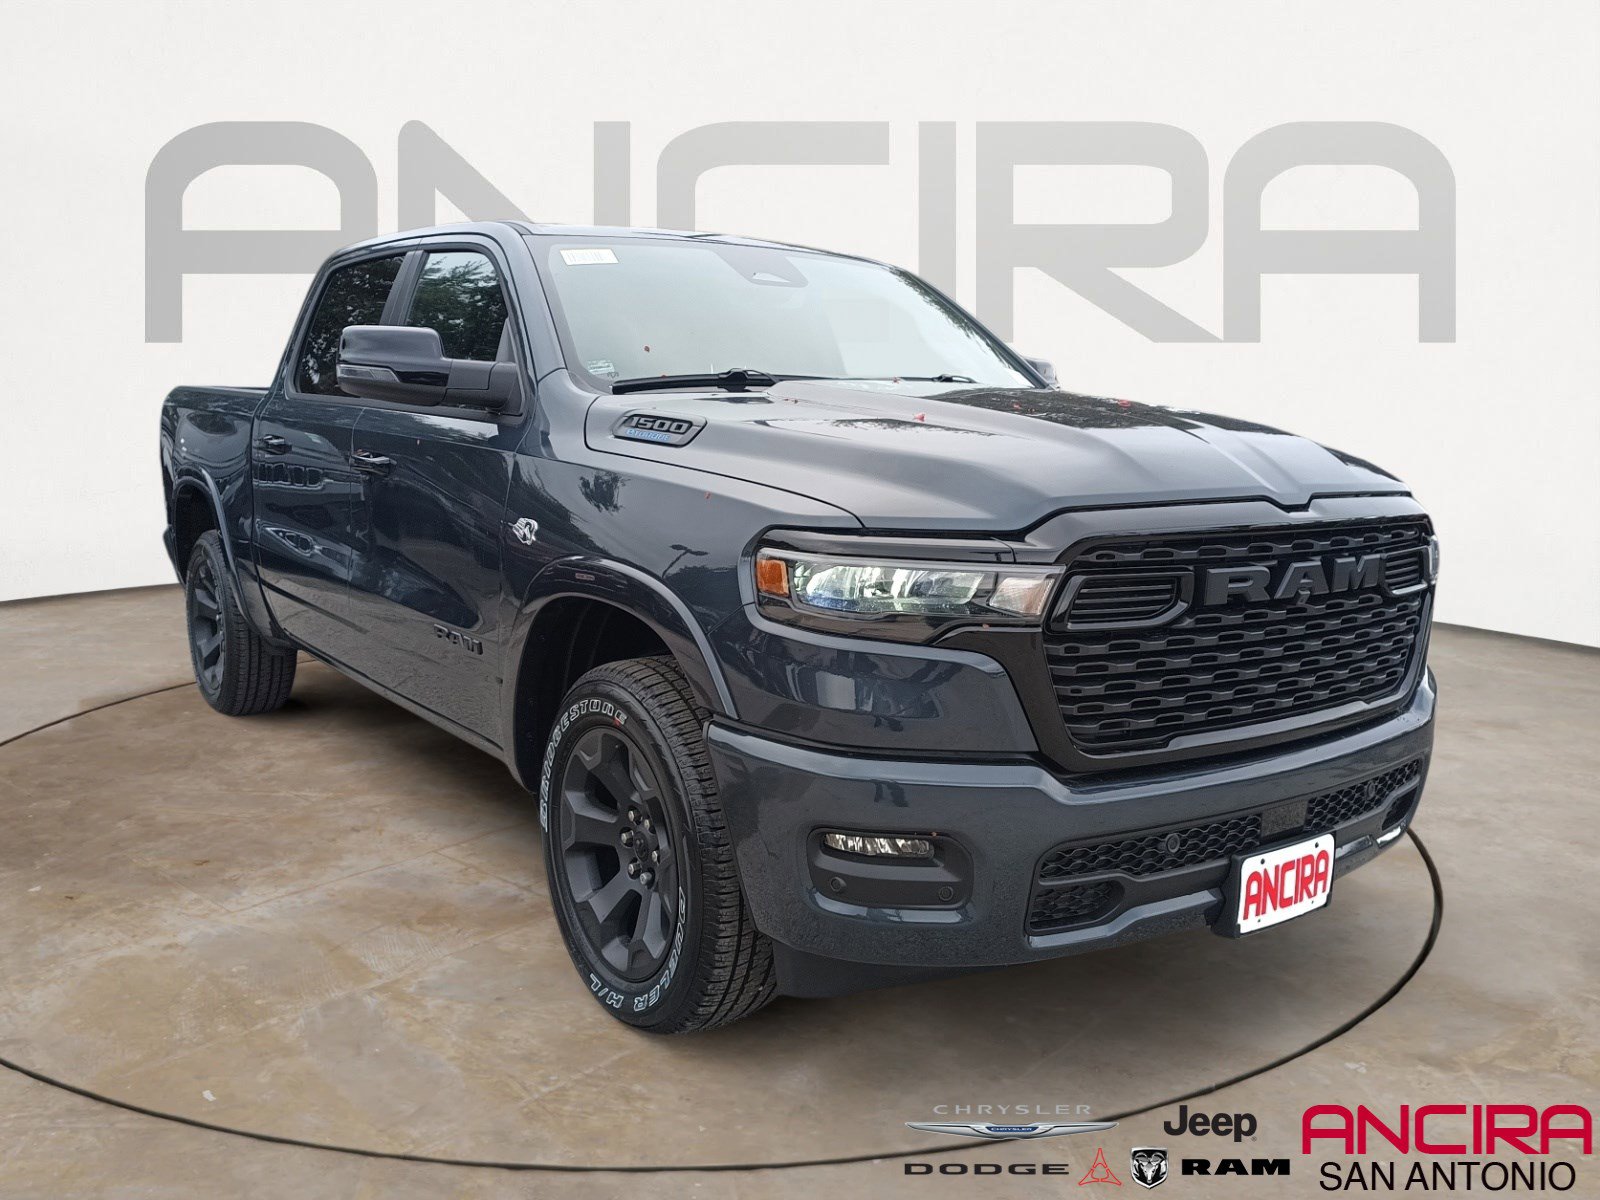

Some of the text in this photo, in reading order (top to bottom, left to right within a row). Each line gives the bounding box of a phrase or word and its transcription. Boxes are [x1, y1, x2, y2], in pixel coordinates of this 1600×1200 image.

[629, 416, 689, 433] 1500
[1204, 553, 1381, 606] RAM
[540, 699, 627, 832] BRIDGESTONE
[1243, 850, 1329, 920] ANCIRA
[589, 886, 686, 1012] DUELER H/L
